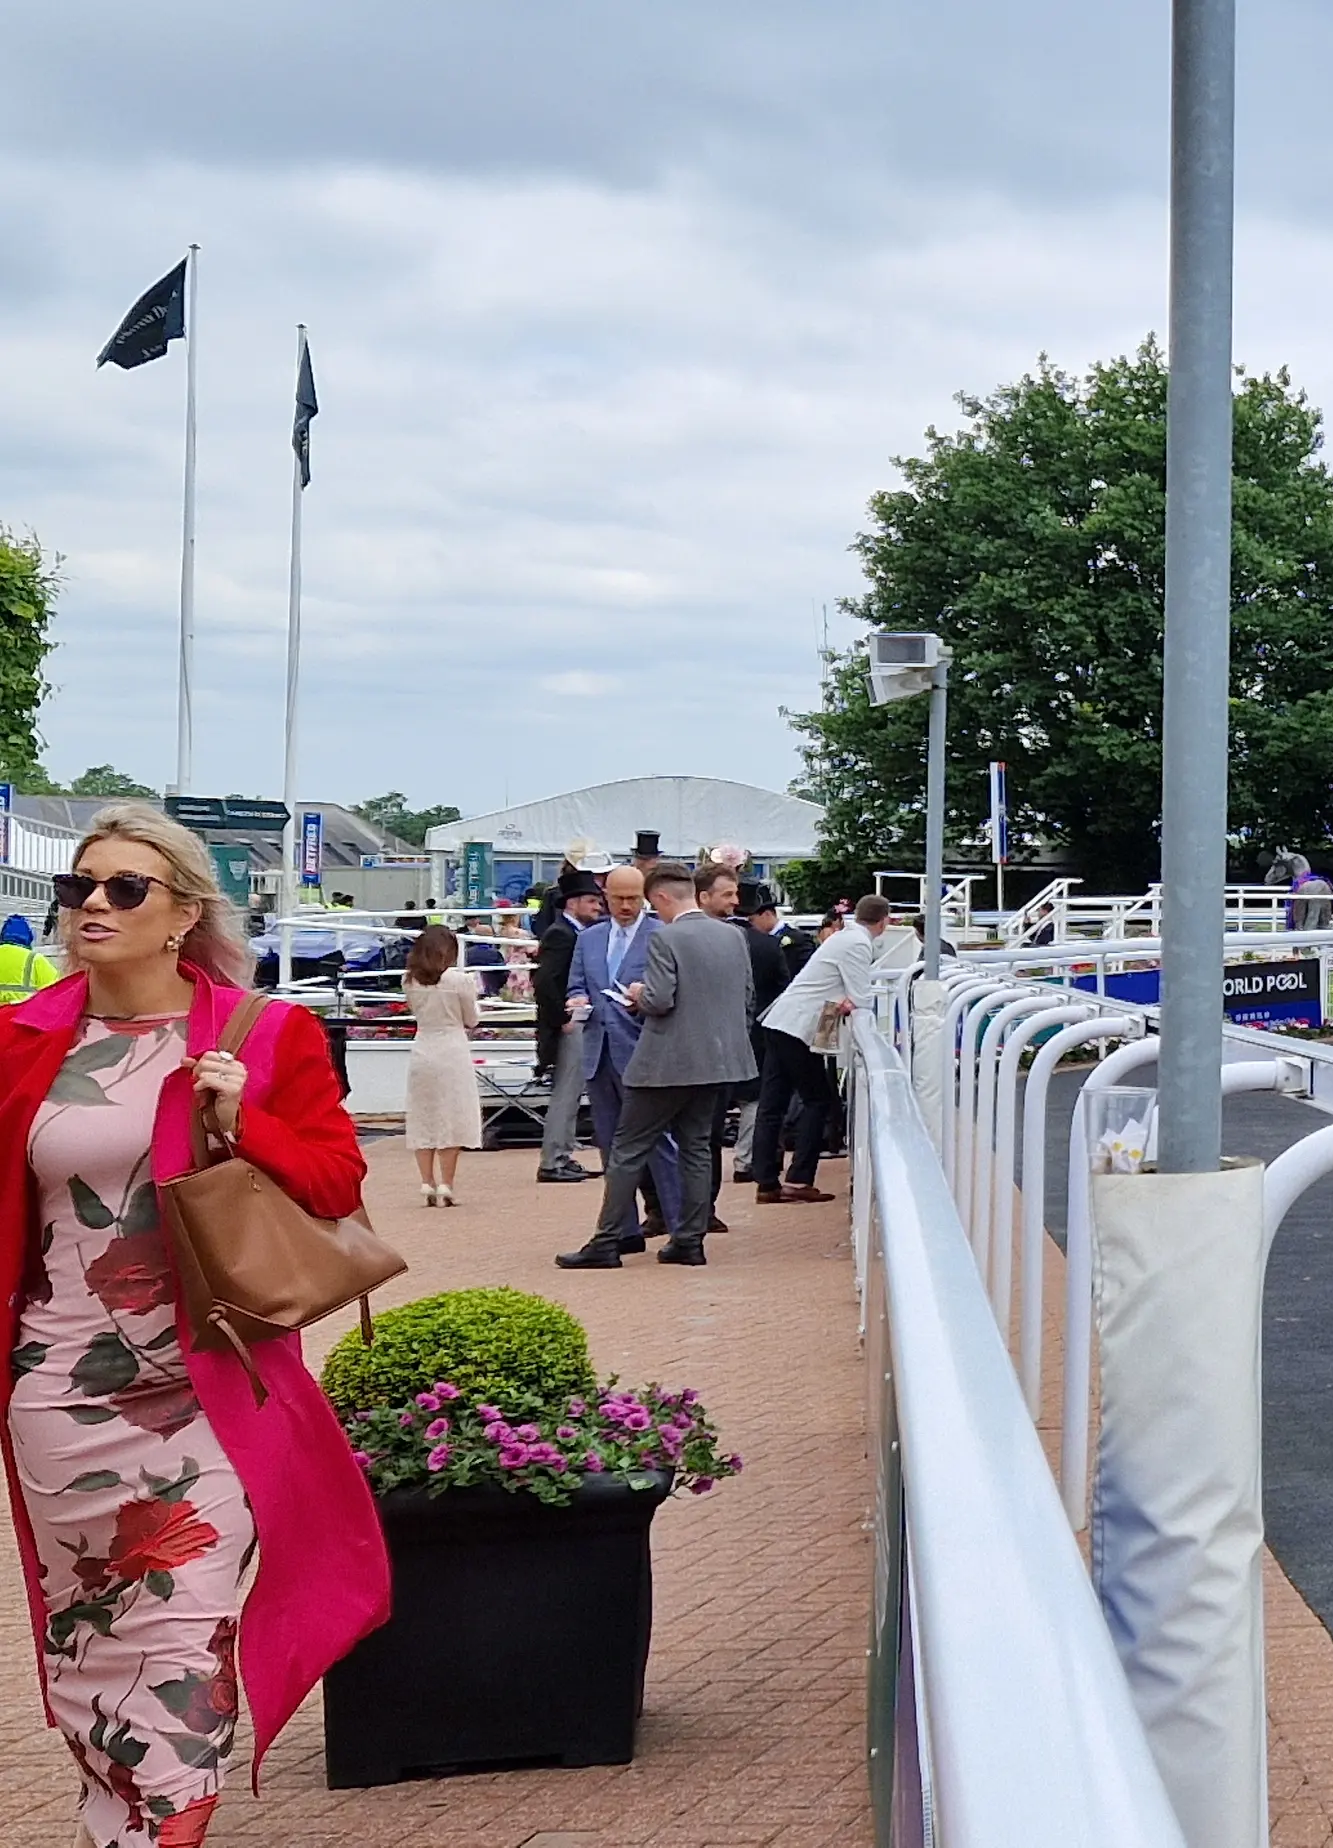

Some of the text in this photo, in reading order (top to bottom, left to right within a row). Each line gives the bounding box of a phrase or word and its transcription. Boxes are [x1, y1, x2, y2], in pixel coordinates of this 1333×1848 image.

[306, 823, 317, 872] BETFRED
[1223, 972, 1308, 996] ORLD POOL
